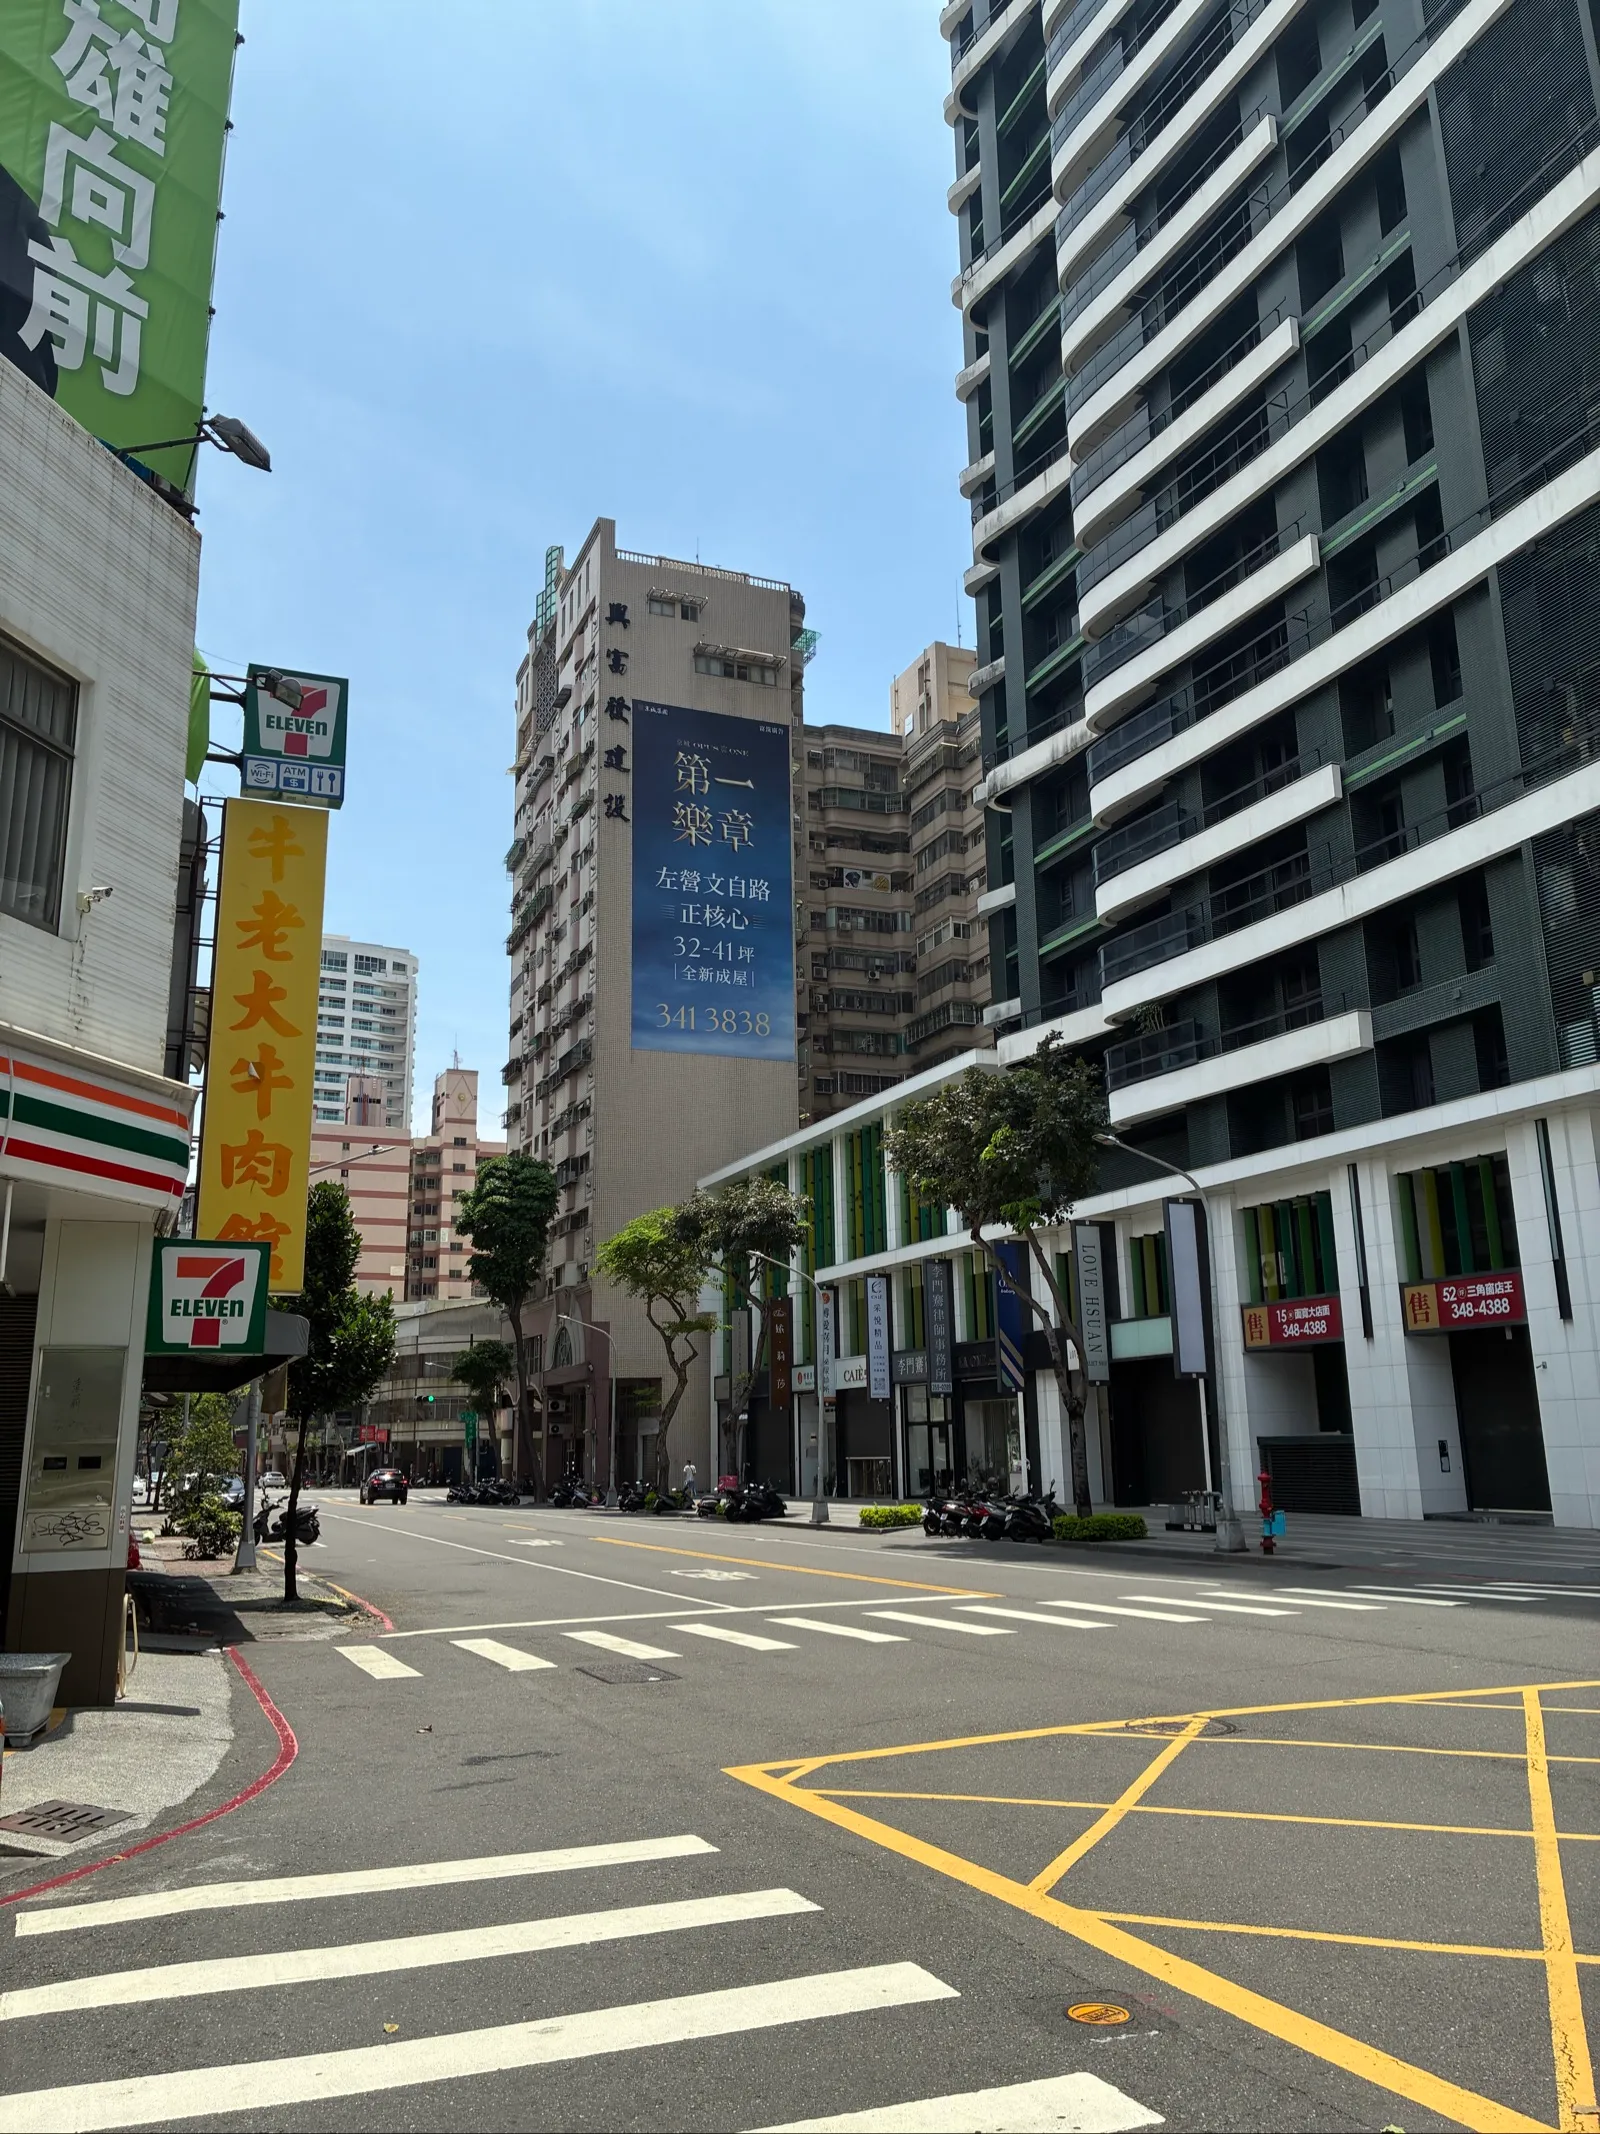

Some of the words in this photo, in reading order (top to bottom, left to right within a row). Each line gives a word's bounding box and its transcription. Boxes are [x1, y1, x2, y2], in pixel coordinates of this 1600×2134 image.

[250, 768, 274, 779] Wi-Fi
[283, 766, 306, 777] ATM
[672, 750, 755, 796] 第一
[672, 801, 755, 853] 樂章
[655, 866, 771, 902] 左營文自路
[679, 903, 749, 931] 正核心
[681, 964, 748, 987] 全新成屋
[656, 1003, 696, 1031] 341
[704, 1007, 771, 1037] 3838
[1082, 1245, 1098, 1287] LOVE
[1408, 1291, 1431, 1325] 售
[1451, 1298, 1511, 1320] 348-4388
[1085, 1296, 1103, 1353] HSUAN
[1246, 1311, 1264, 1342] 售
[1282, 1320, 1328, 1339] 348-4388
[897, 1356, 928, 1376] 李門騫
